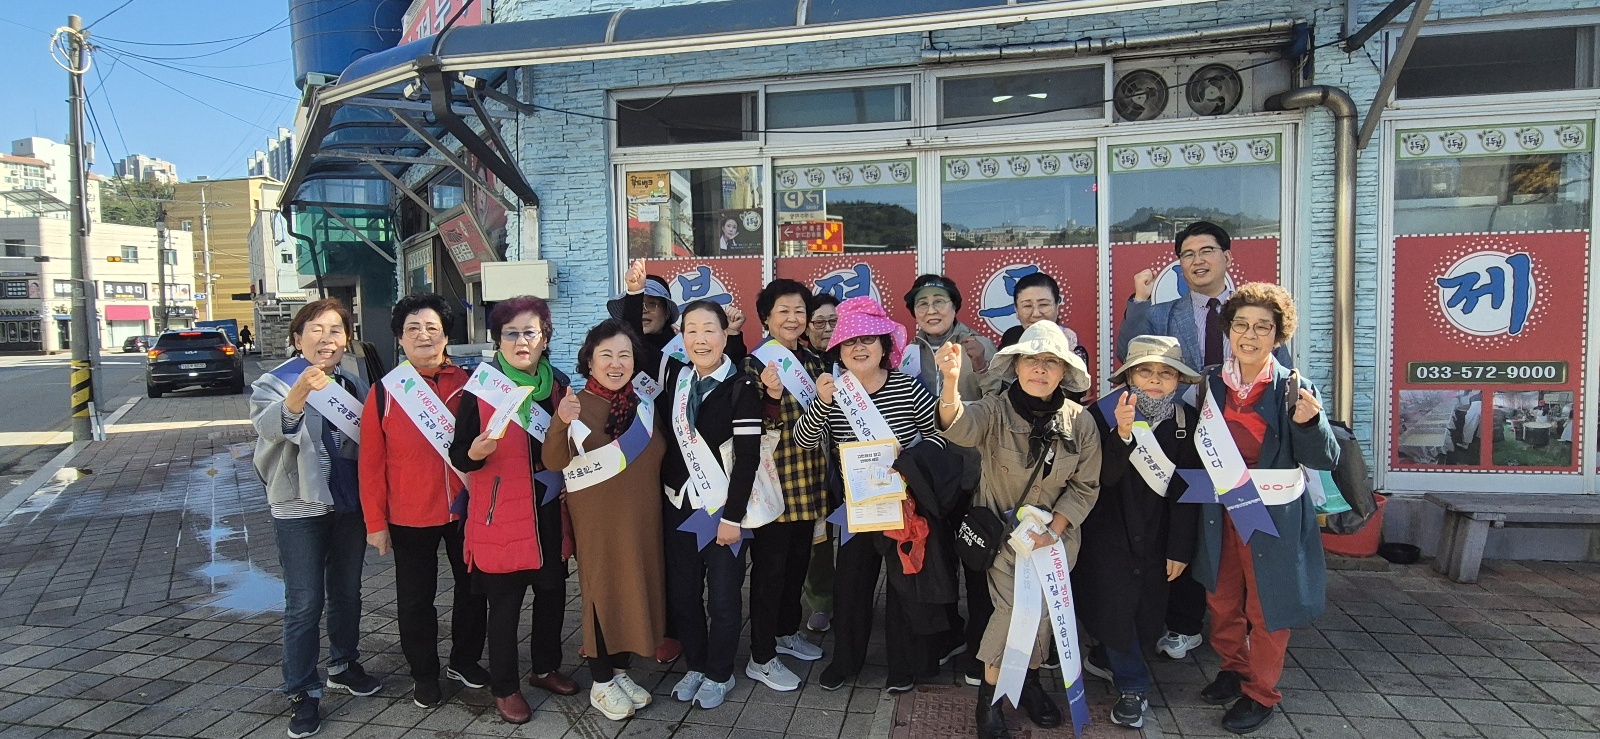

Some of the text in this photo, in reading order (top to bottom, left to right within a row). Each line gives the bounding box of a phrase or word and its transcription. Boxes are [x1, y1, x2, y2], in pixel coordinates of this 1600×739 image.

[1437, 254, 1530, 334] 제
[794, 368, 814, 394] 소중한
[1416, 366, 1556, 379] 033-572-9000
[416, 390, 439, 414] 소중한
[437, 414, 455, 434] 생명
[838, 388, 852, 406] 지킬
[851, 408, 858, 416] 수
[853, 391, 868, 411] 생명
[418, 410, 445, 440] 지킬 수
[682, 440, 689, 448] 수
[686, 450, 711, 490] 있습니다
[1198, 426, 1223, 468] 있습니다
[1050, 547, 1070, 607] 소중한 생명
[1046, 572, 1072, 660] 지킬 수 있습니다
